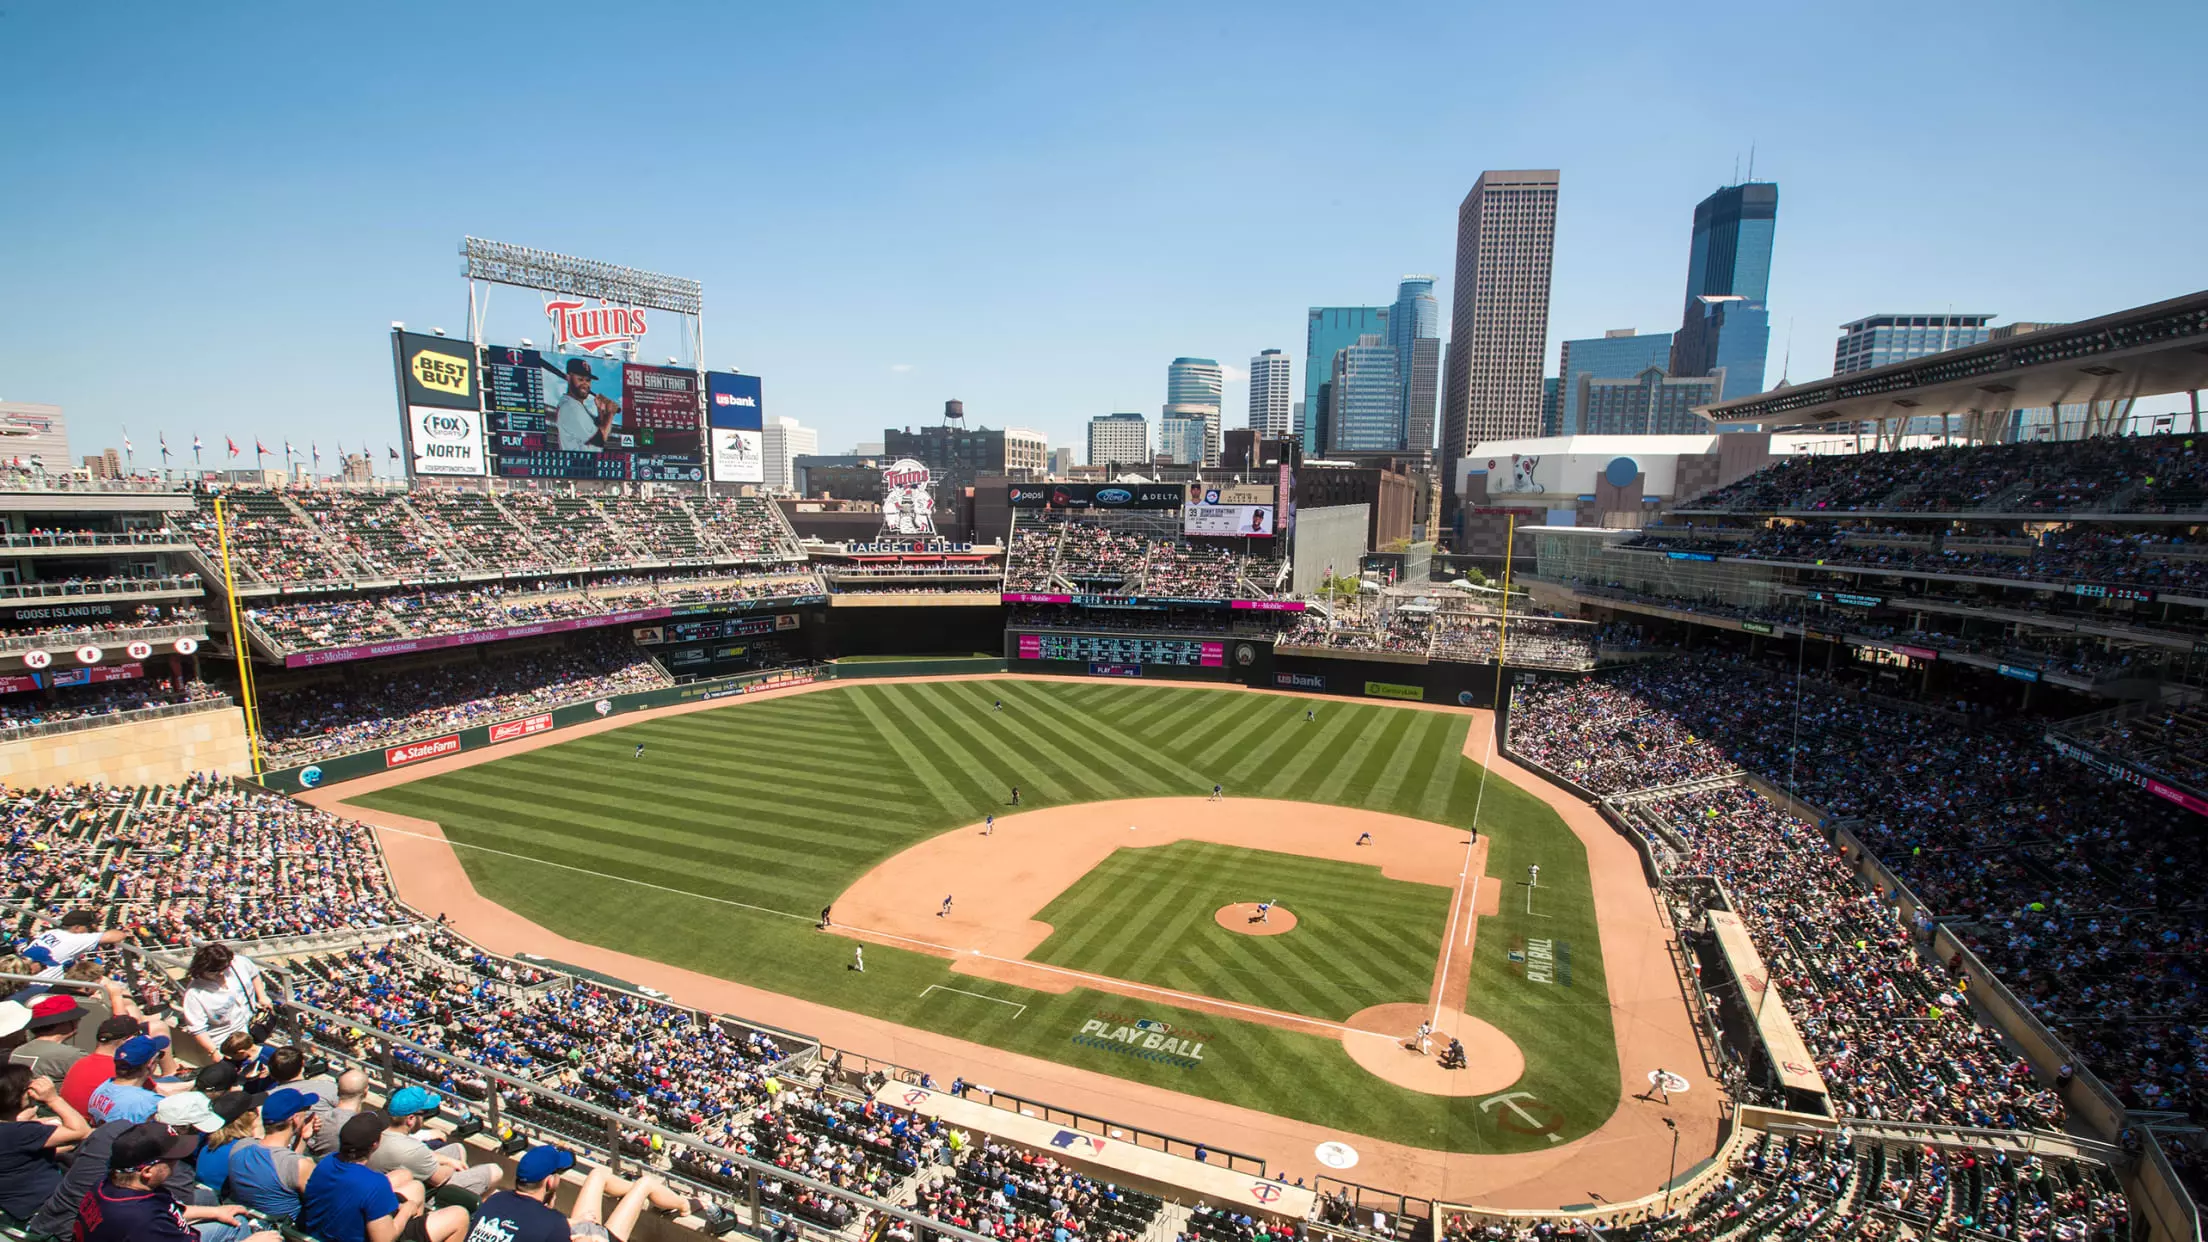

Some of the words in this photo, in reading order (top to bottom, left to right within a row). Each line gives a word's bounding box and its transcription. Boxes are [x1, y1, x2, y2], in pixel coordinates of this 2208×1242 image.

[545, 298, 648, 345] Twins
[420, 356, 467, 378] BEST
[422, 369, 463, 388] BUY
[626, 369, 643, 387] 39
[644, 375, 687, 391] SANTANA
[432, 416, 461, 431] FOX
[502, 435, 522, 446] PLAY
[426, 443, 471, 458] NORTH
[884, 469, 929, 489] Twins
[1022, 490, 1044, 500] pepsi
[1103, 491, 1124, 501] Ford
[849, 542, 912, 553] TARGET
[927, 542, 973, 553] FIELD
[16, 609, 50, 620] GOOSE
[52, 606, 90, 618] ISLAND
[91, 605, 112, 615] PUB
[371, 646, 392, 654] MAJOR
[392, 643, 417, 652] LEAGUE
[32, 655, 45, 665] 14
[408, 745, 432, 759] State
[432, 739, 457, 753] Farm
[1527, 938, 1553, 960] BALL
[1527, 957, 1553, 984] PLAY
[1080, 1018, 1146, 1044] PLAY
[1142, 1033, 1204, 1060] BALL
